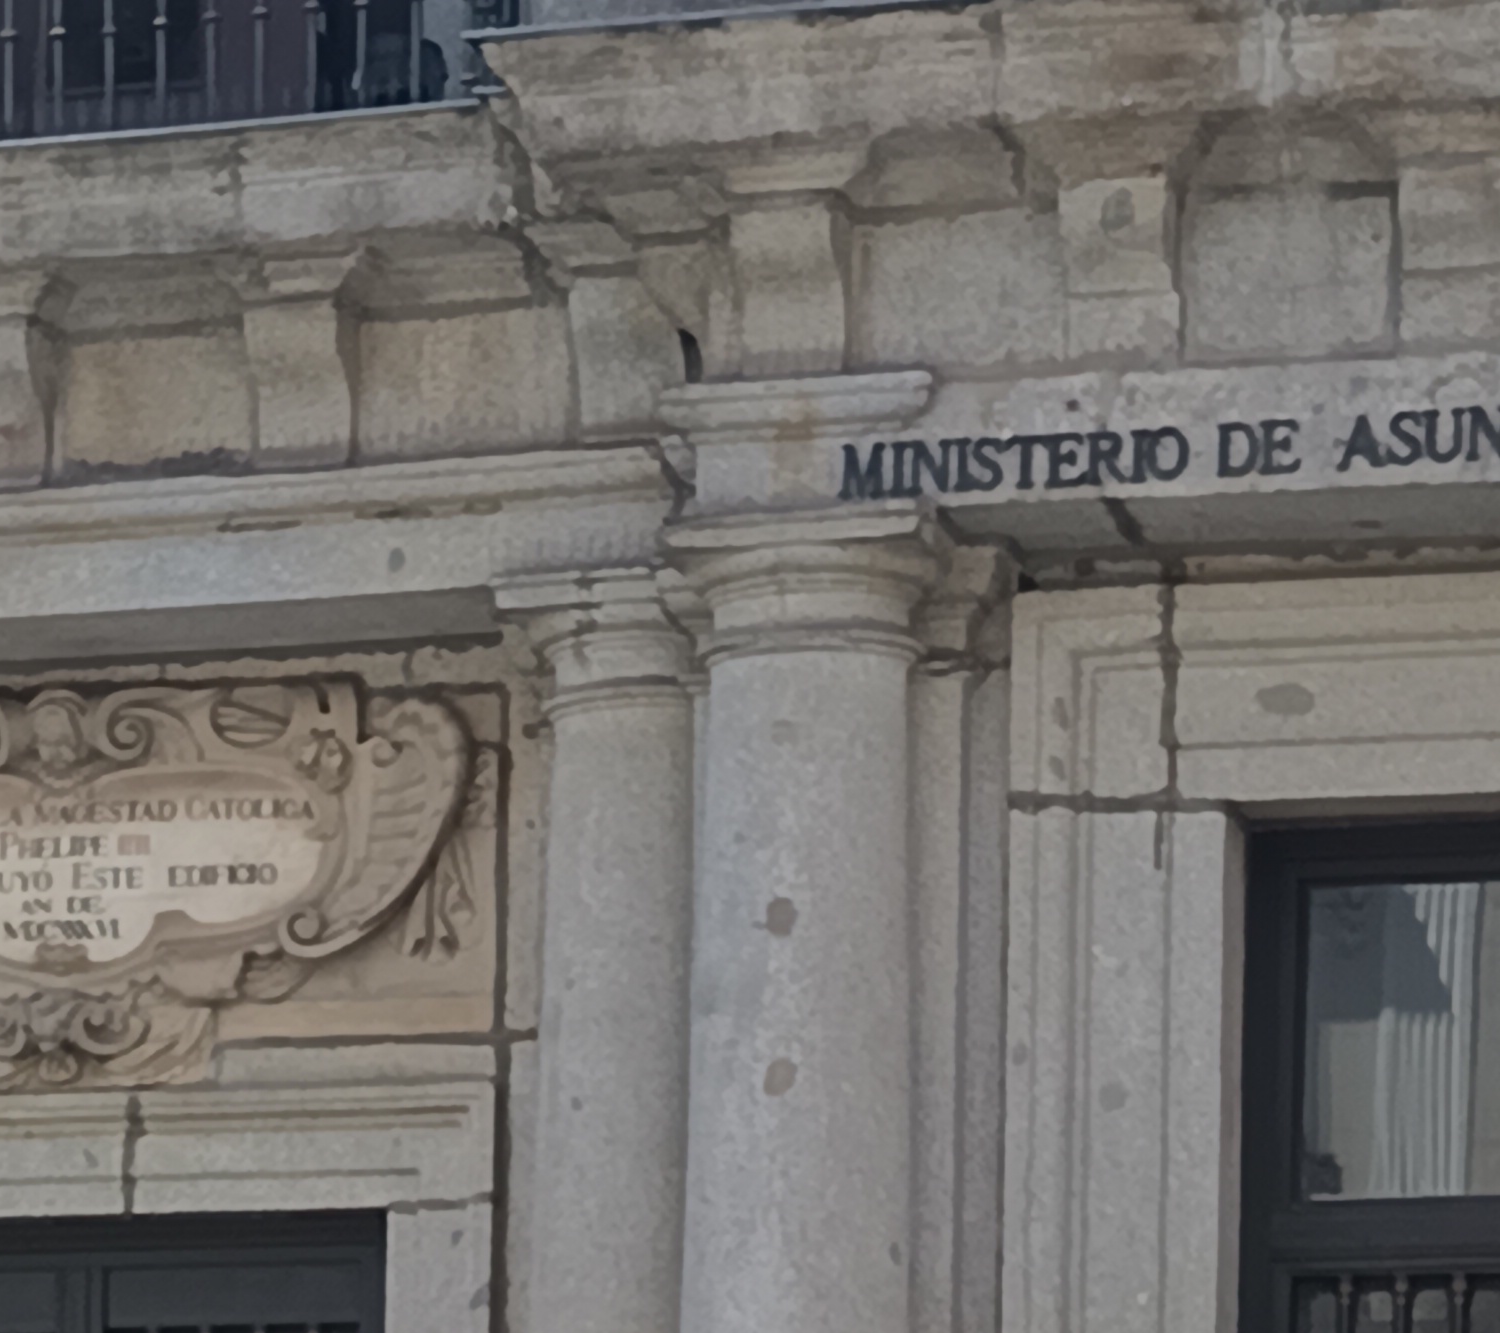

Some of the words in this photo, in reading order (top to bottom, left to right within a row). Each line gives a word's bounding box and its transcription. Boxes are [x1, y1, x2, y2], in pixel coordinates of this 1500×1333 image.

[838, 427, 1190, 499] MINISTERIO
[1216, 419, 1301, 478] DE
[71, 861, 144, 890] ESTE
